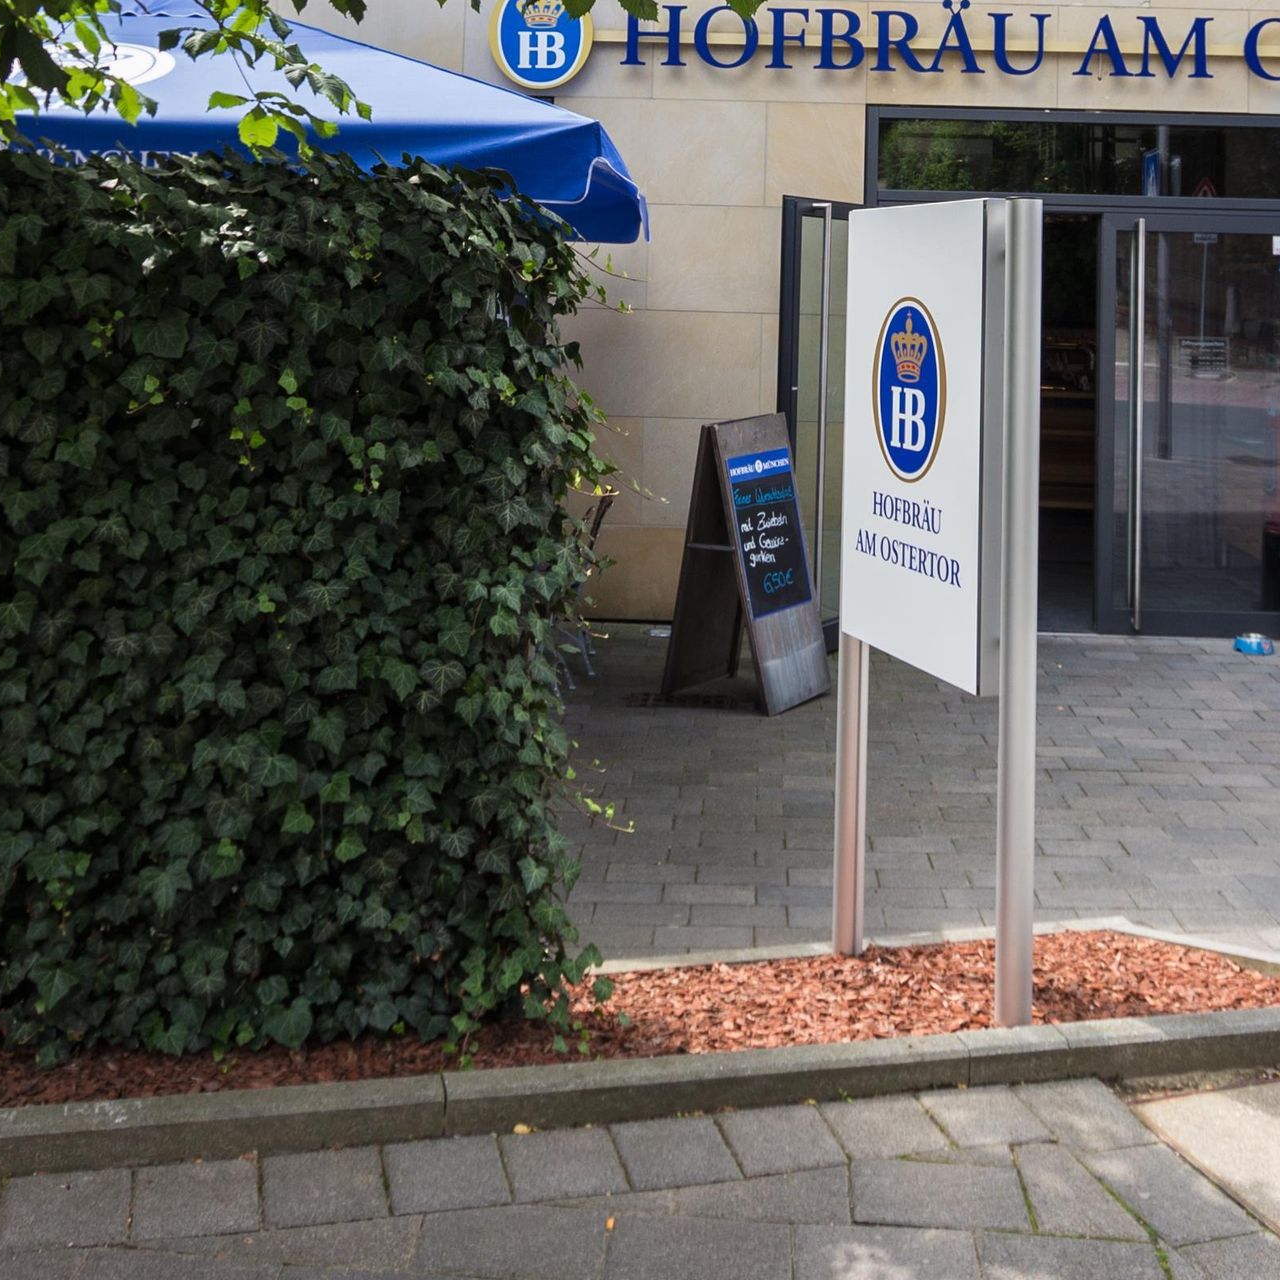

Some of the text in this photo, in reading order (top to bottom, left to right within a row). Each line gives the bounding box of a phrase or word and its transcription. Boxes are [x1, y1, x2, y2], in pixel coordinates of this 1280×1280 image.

[517, 30, 567, 71] HB
[1071, 13, 1215, 80] AM
[890, 385, 926, 452] HB
[872, 491, 942, 534] HOFBRÄU
[743, 535, 756, 552] und
[856, 528, 961, 588] AM OSTERTOR
